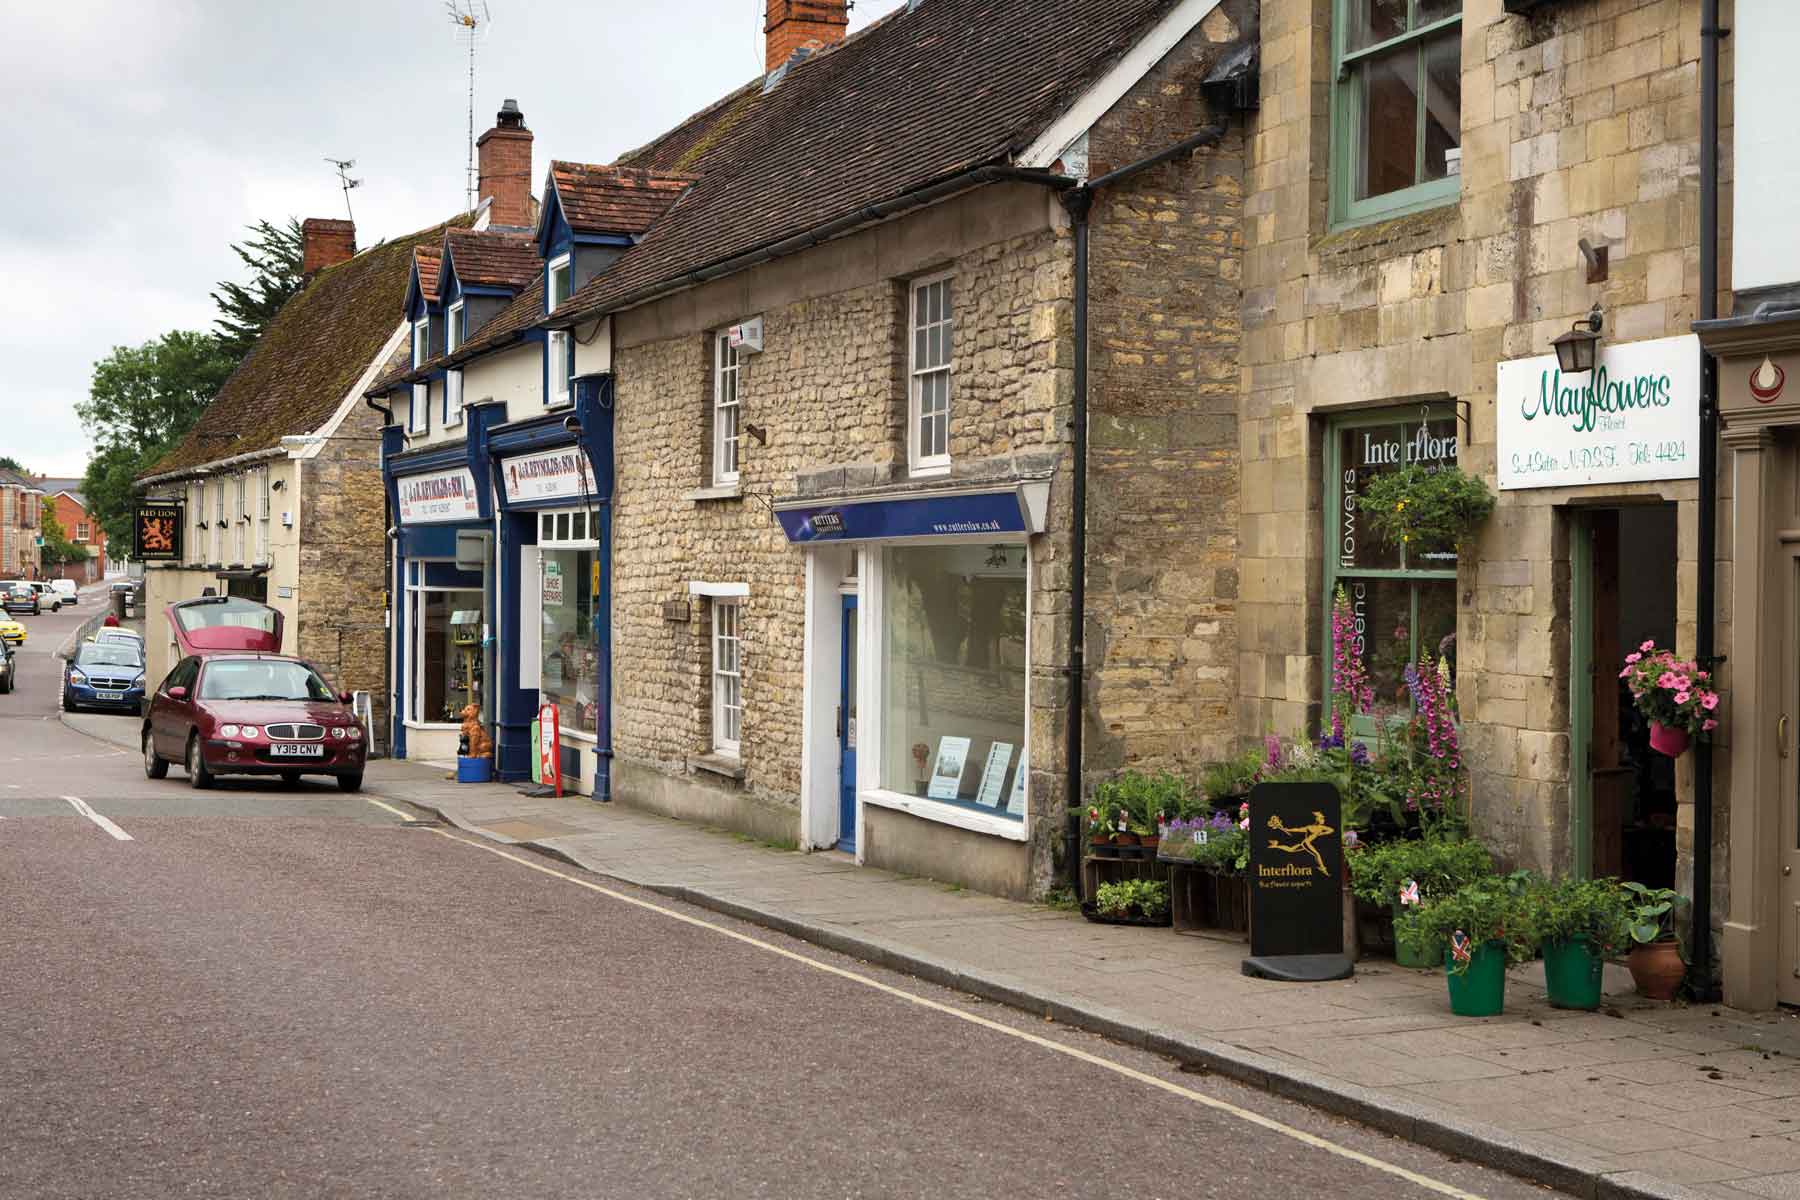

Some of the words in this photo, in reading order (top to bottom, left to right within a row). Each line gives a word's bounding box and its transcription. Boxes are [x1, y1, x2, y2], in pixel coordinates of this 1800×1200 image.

[1521, 364, 1671, 432] Mayflowers
[1341, 468, 1356, 568] flowers
[277, 744, 298, 754] Y319
[300, 744, 318, 754] CNV
[1258, 863, 1313, 877] Interflora
